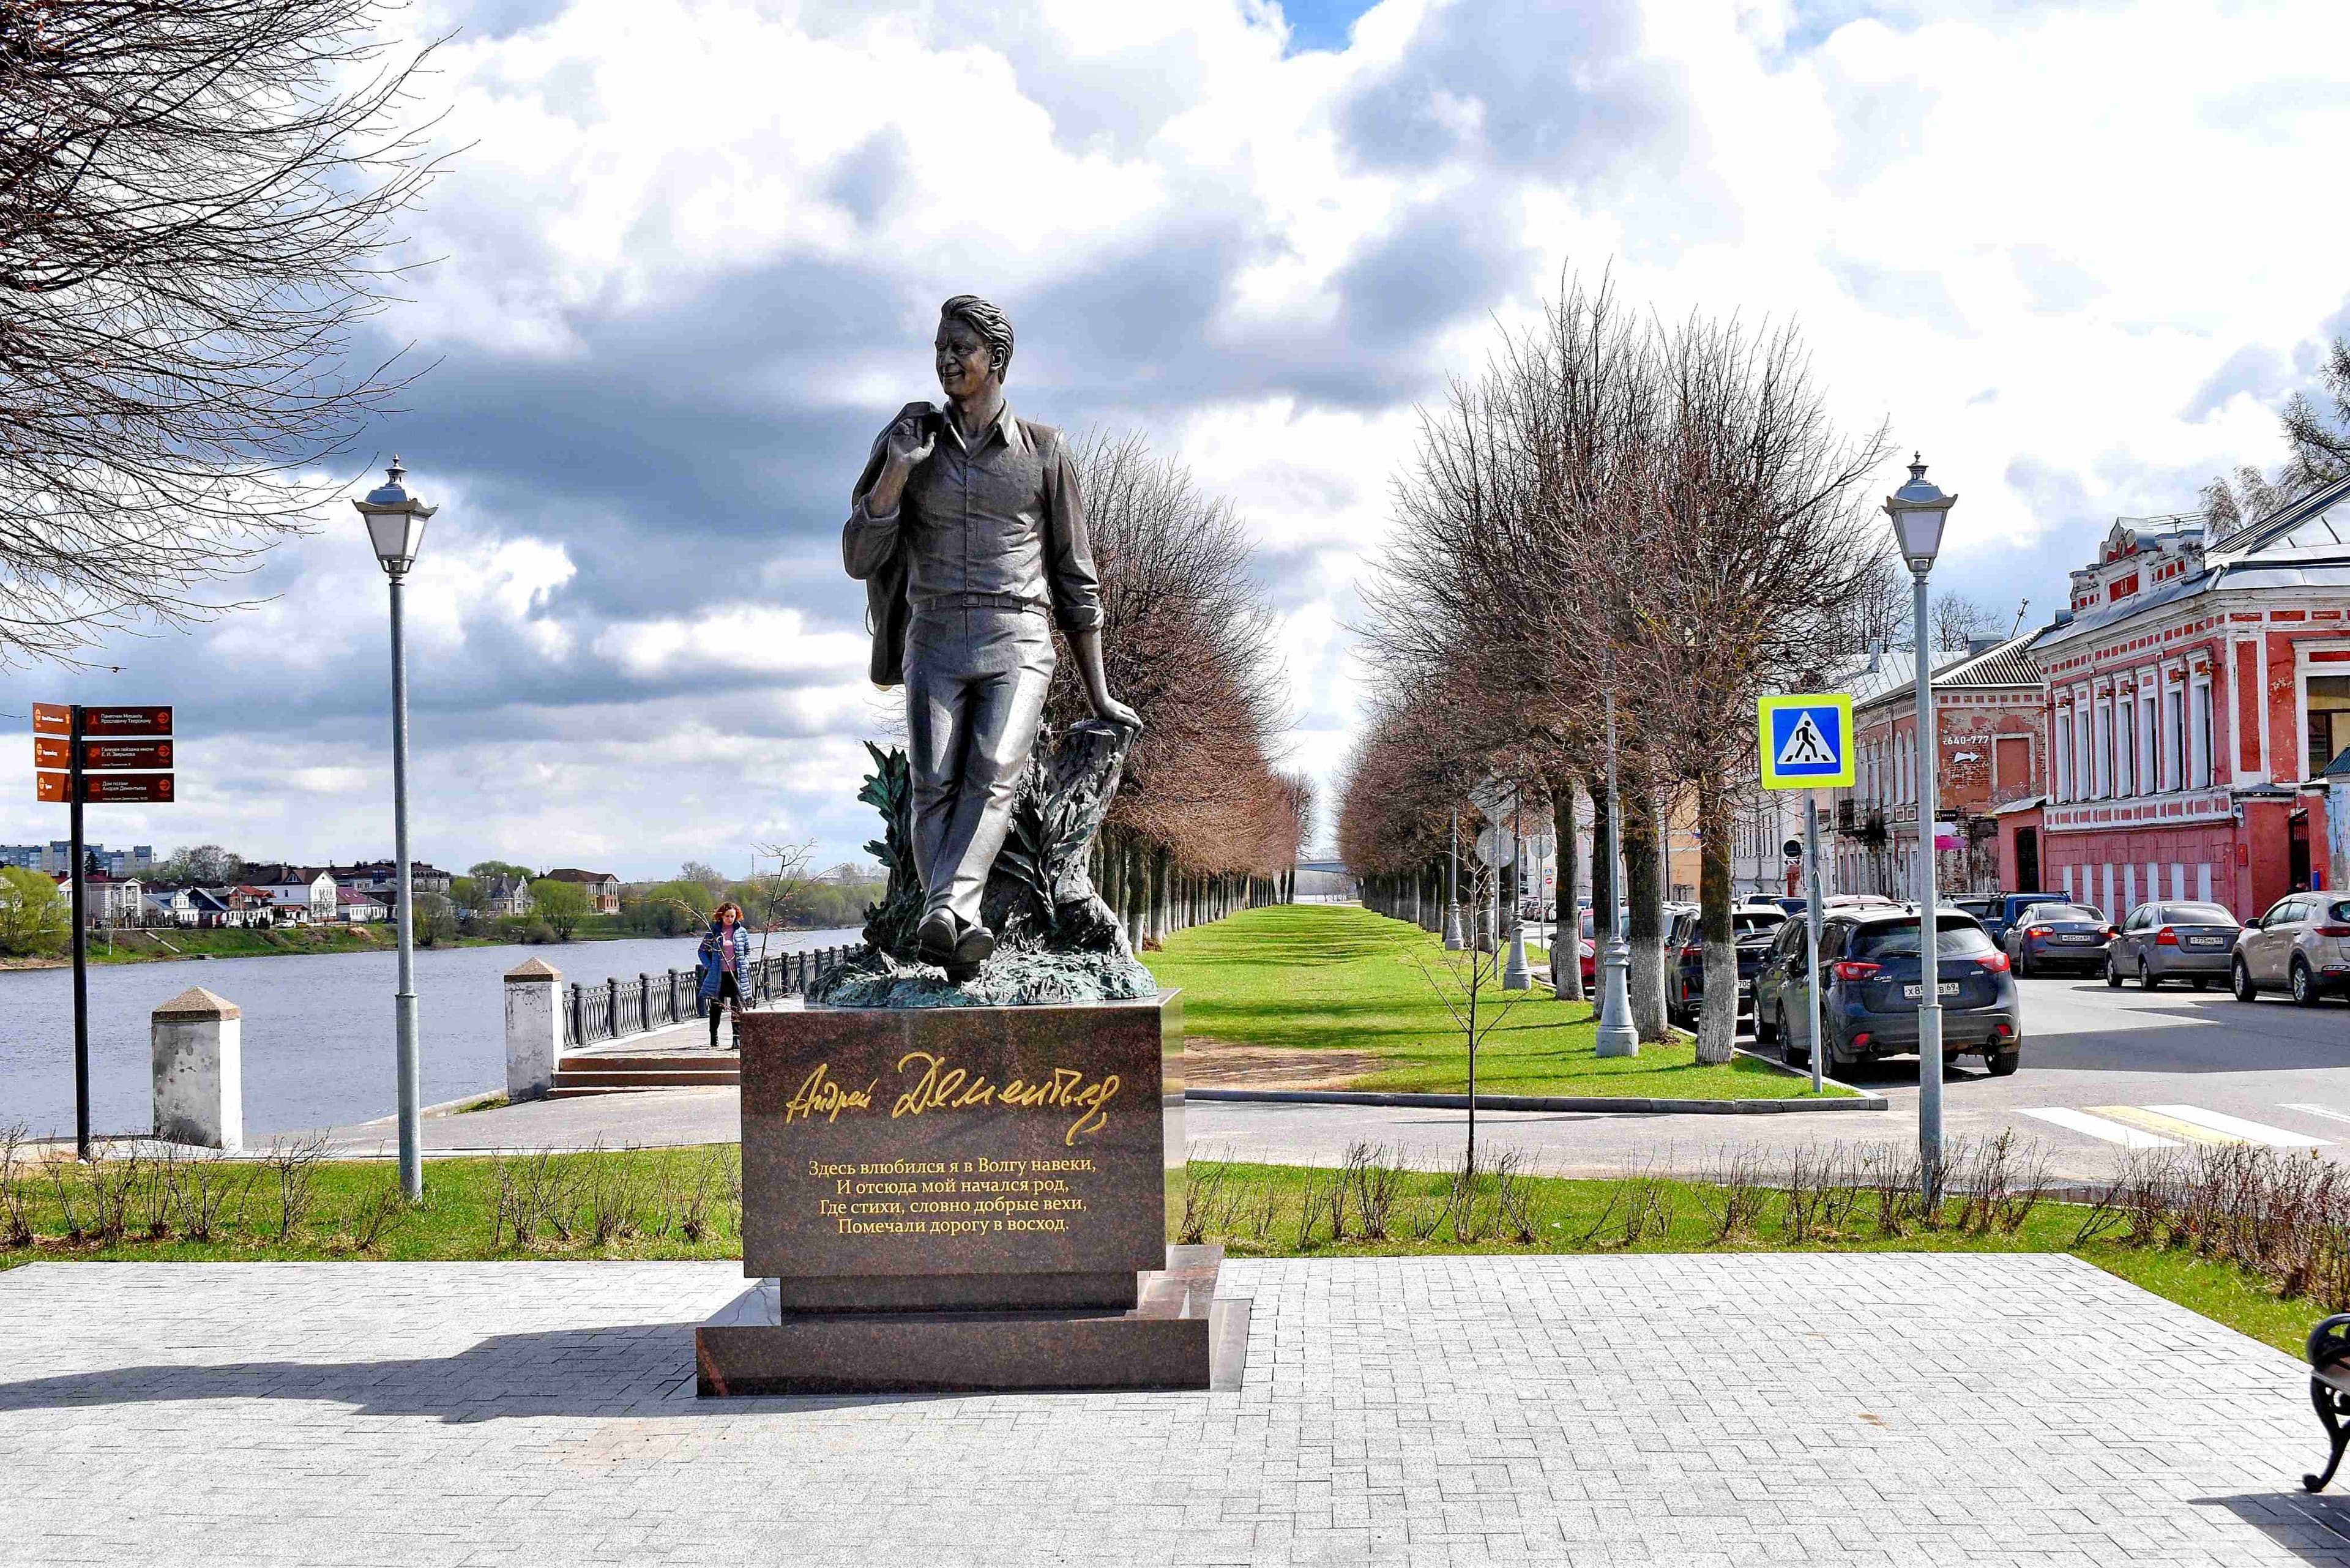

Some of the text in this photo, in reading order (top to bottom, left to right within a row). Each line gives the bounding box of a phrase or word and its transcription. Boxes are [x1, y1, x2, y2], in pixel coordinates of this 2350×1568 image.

[786, 1051, 1119, 1146] Андрей Дементьев
[808, 1157, 1096, 1178] Здесь влюбился я в Волгу навеки,
[837, 1178, 1069, 1196] И отсюда мой начался род,
[820, 1195, 1087, 1217] Где стихи, словно добрые вехи,
[838, 1219, 1069, 1236] Помечали дорогу в восход.
